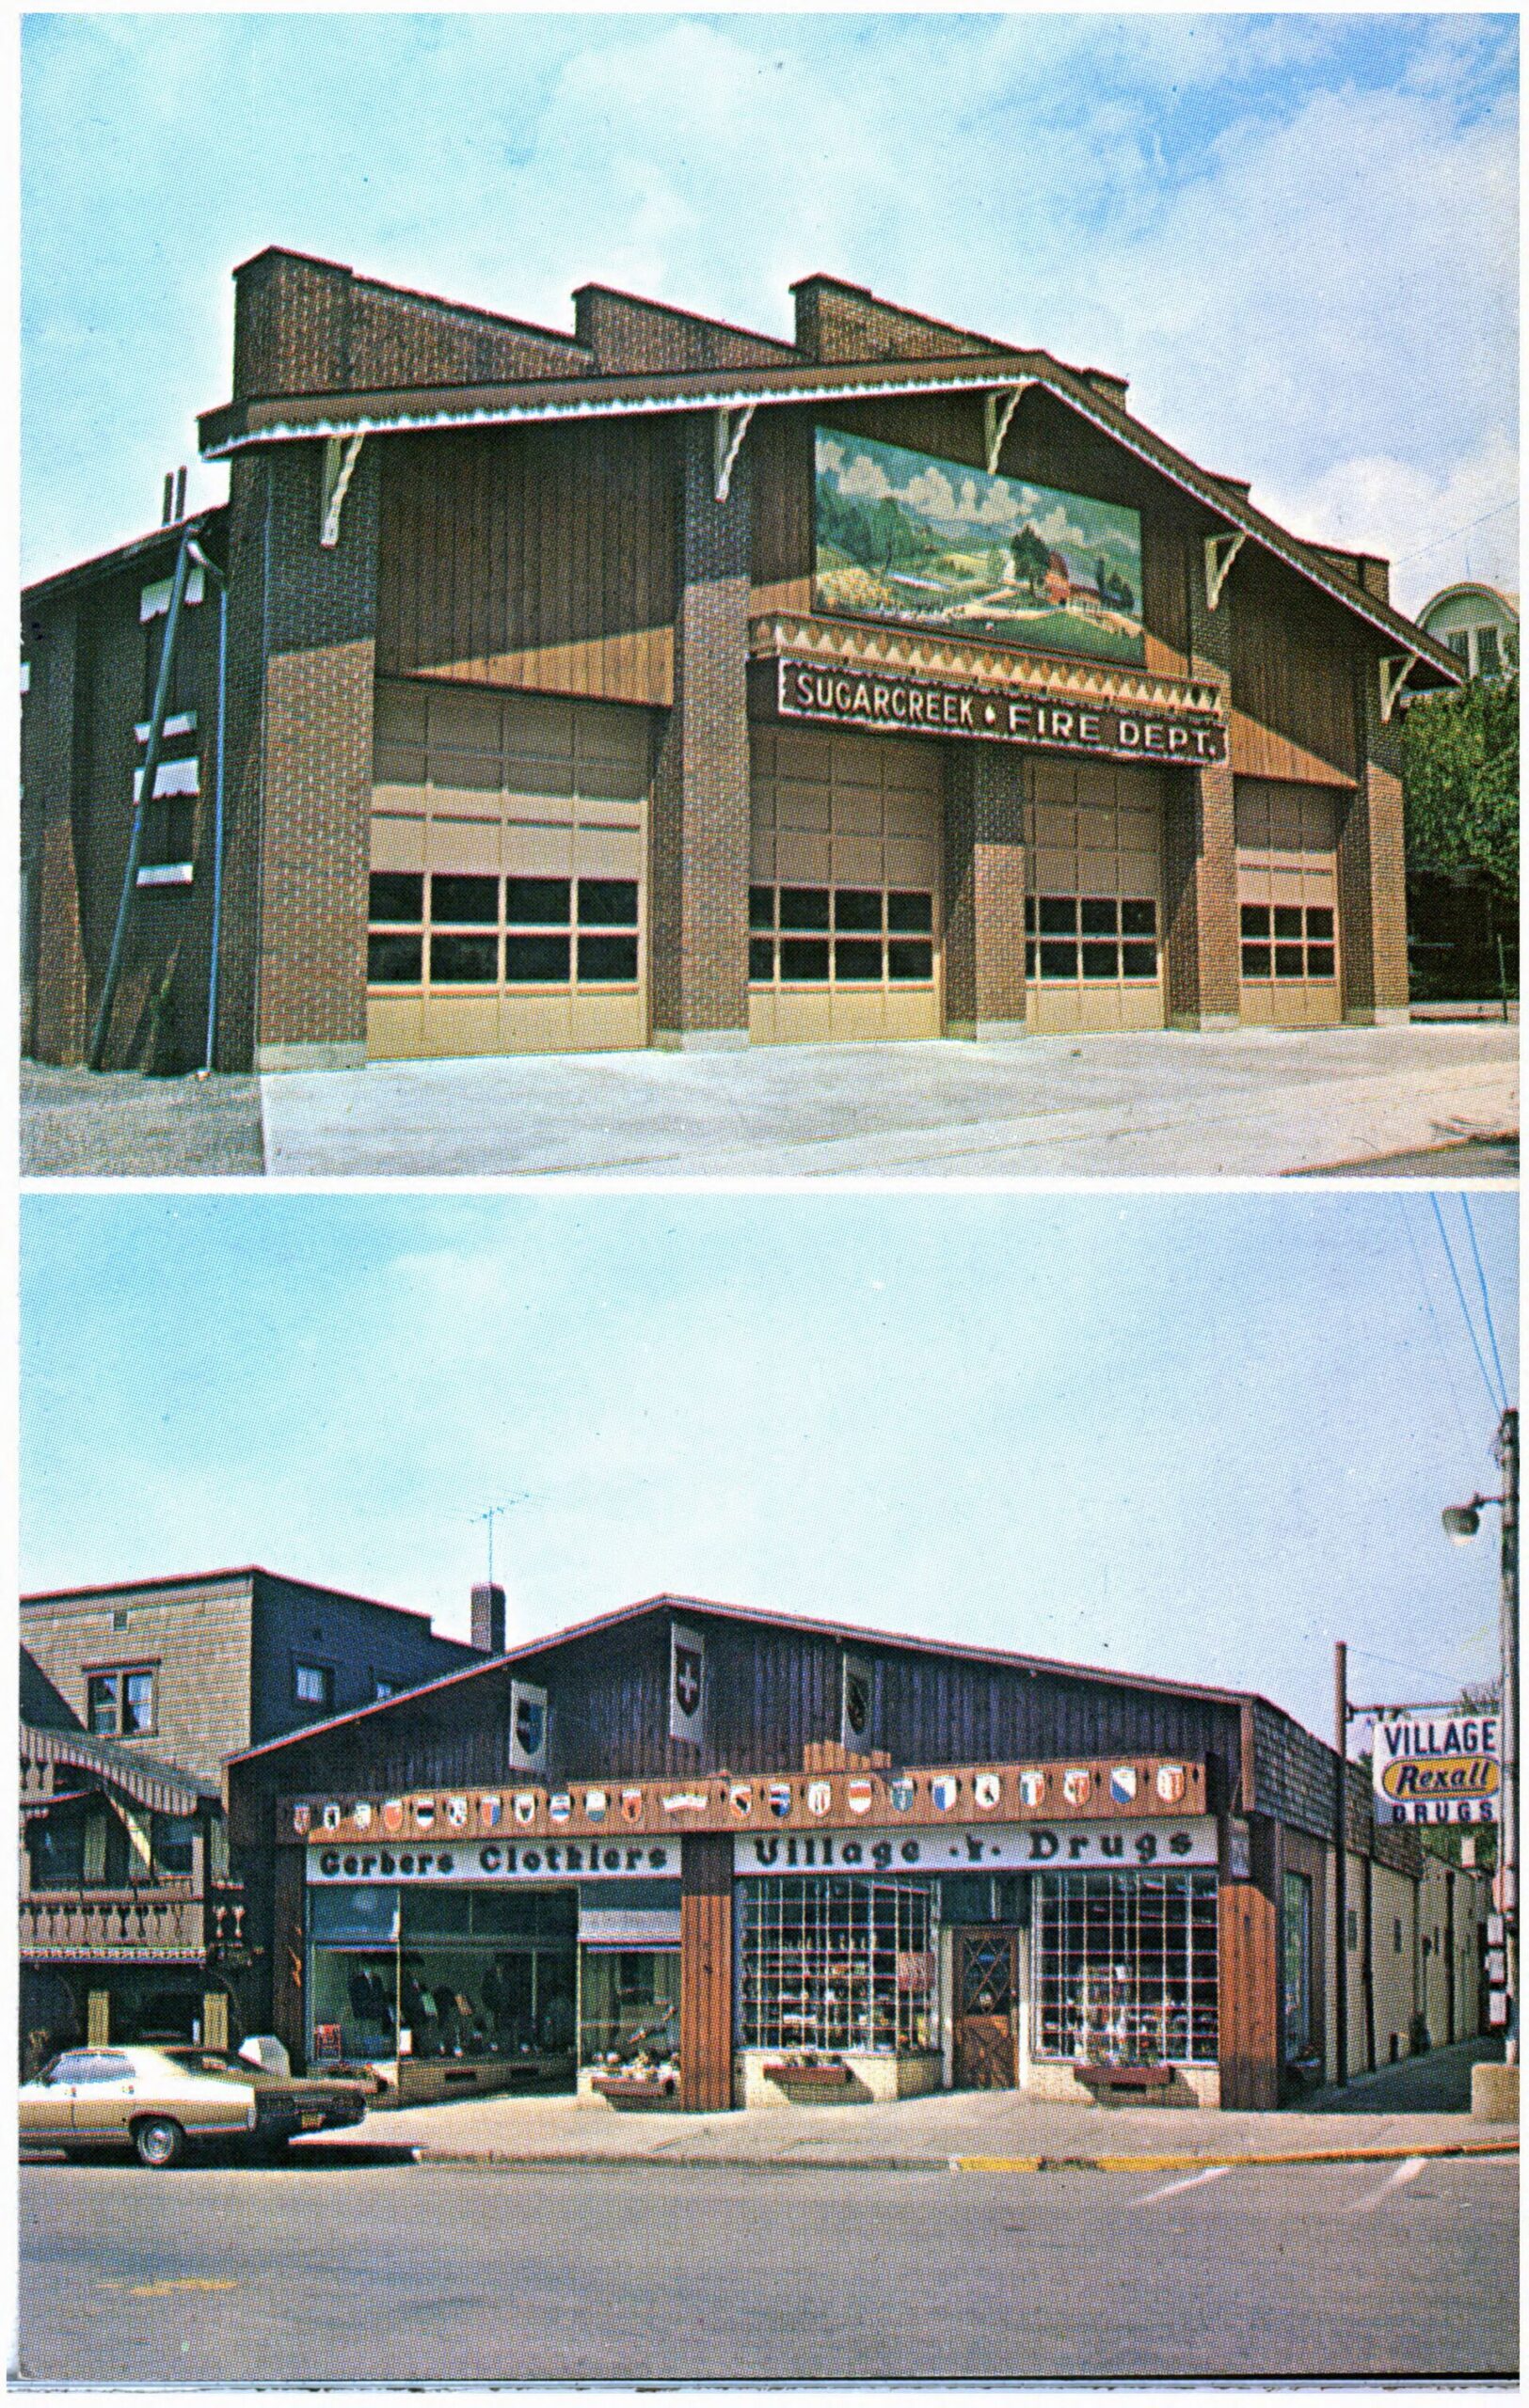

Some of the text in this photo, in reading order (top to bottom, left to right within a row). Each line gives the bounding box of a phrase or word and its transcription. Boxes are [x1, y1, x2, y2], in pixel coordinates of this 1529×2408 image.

[796, 672, 1218, 757] SUGARCREEK FIRE DEPT.
[1384, 1719, 1496, 1756] VILLAGE
[1395, 1761, 1489, 1796] Rexall
[1393, 1800, 1493, 1824] DRUGS
[319, 1841, 668, 1877] Gerbers Clothiers
[753, 1830, 1194, 1870] Village Drugs
